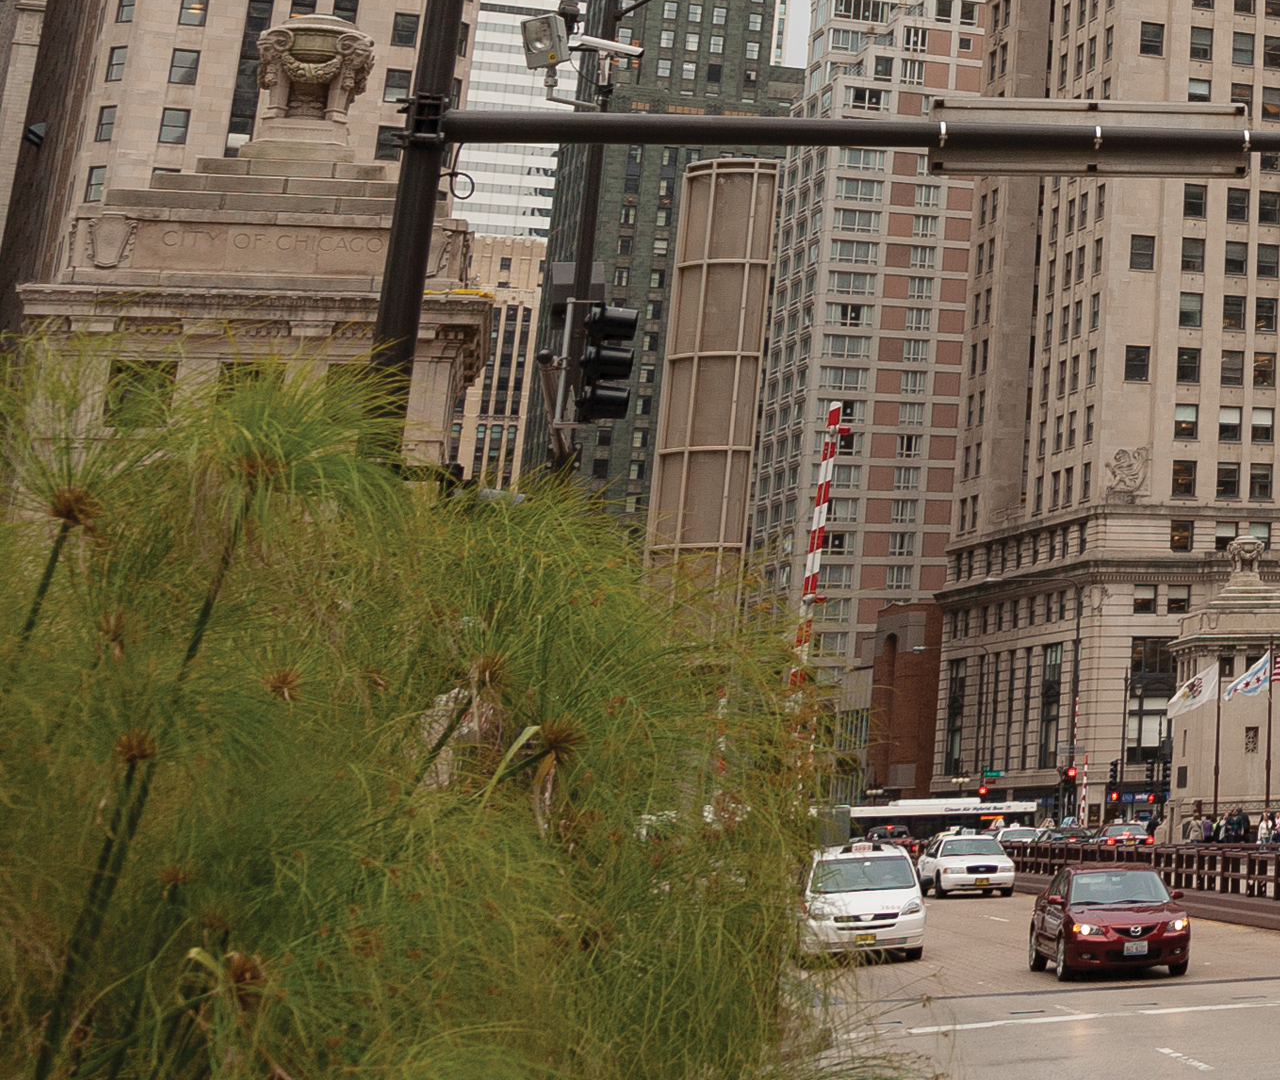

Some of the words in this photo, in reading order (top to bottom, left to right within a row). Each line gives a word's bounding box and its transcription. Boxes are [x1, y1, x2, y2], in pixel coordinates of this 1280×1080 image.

[162, 230, 227, 248] CITY
[233, 233, 266, 249] OF
[276, 234, 384, 253] CHICAGO
